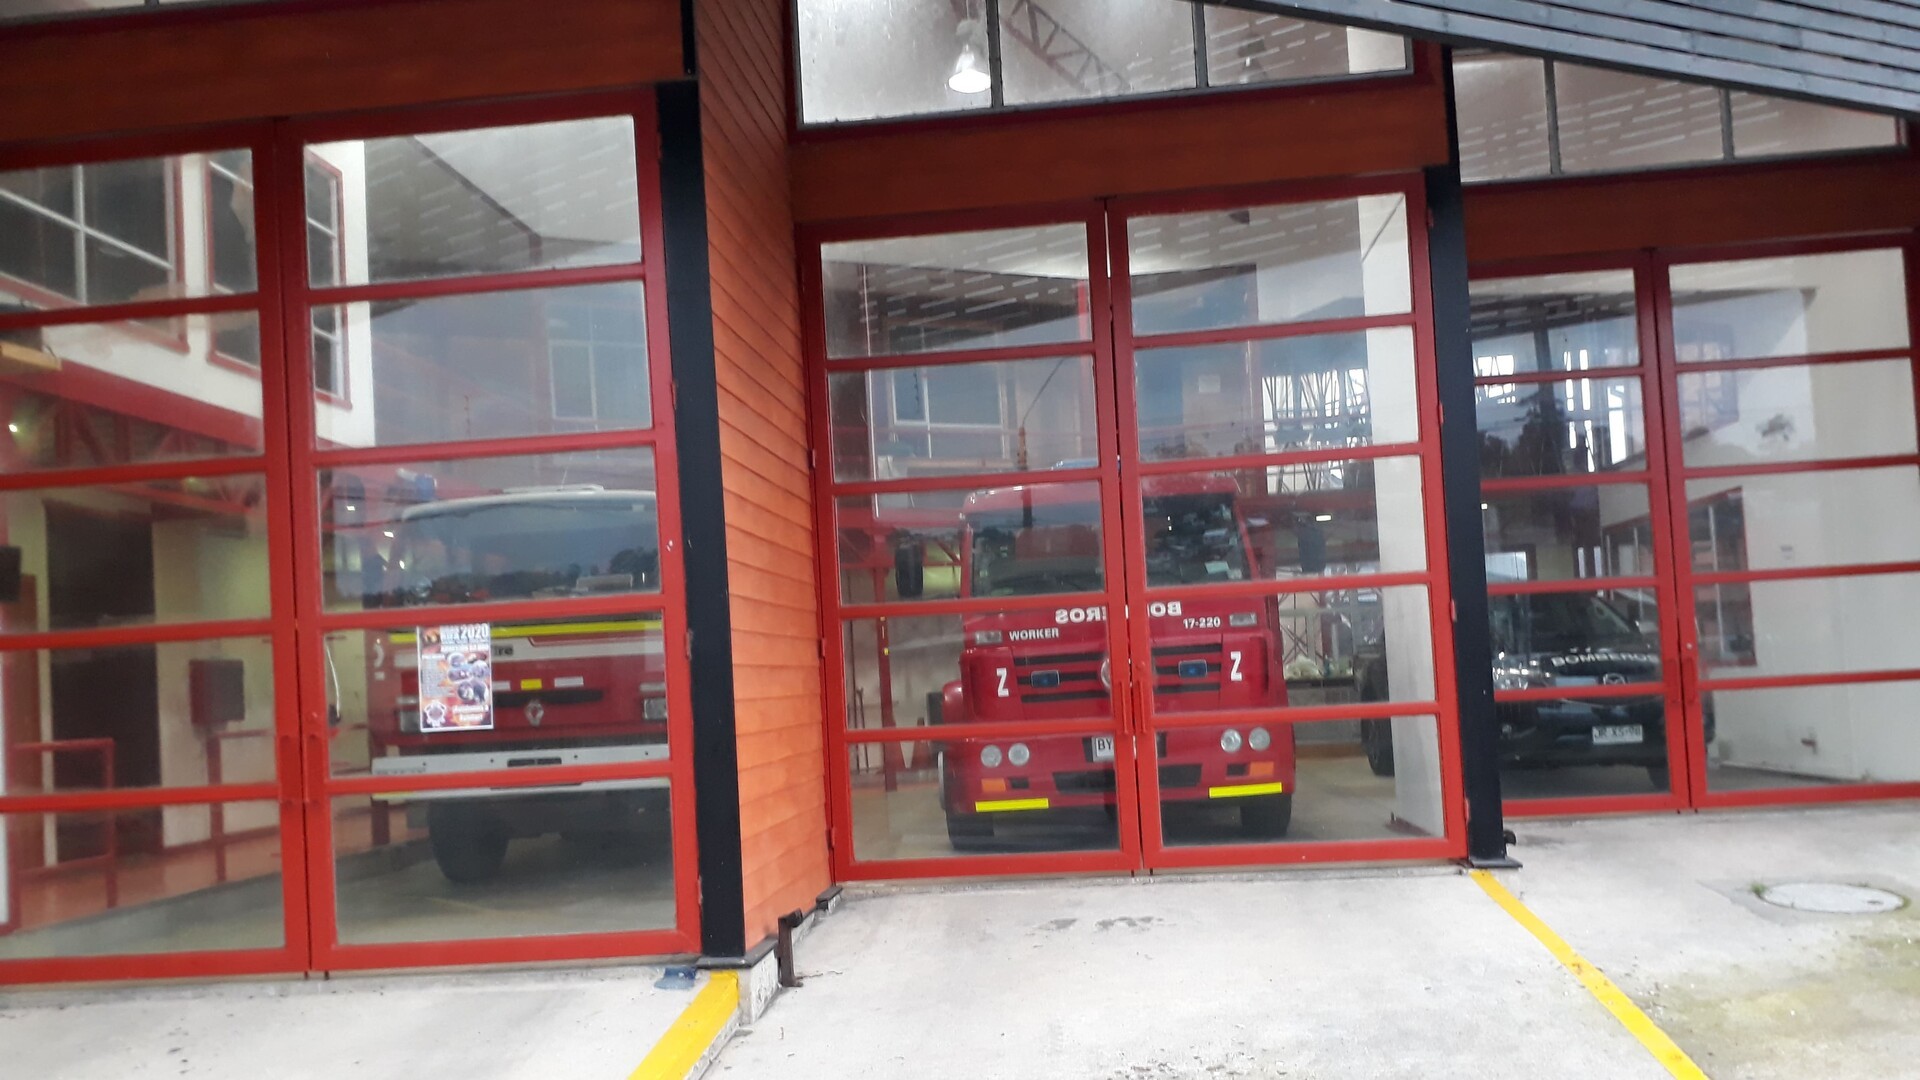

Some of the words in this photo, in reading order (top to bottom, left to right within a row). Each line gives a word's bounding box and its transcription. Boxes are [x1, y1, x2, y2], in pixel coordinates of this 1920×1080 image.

[460, 622, 488, 639] 2020
[1008, 627, 1059, 641] WORKER
[1552, 652, 1660, 667] BOMBEROS
